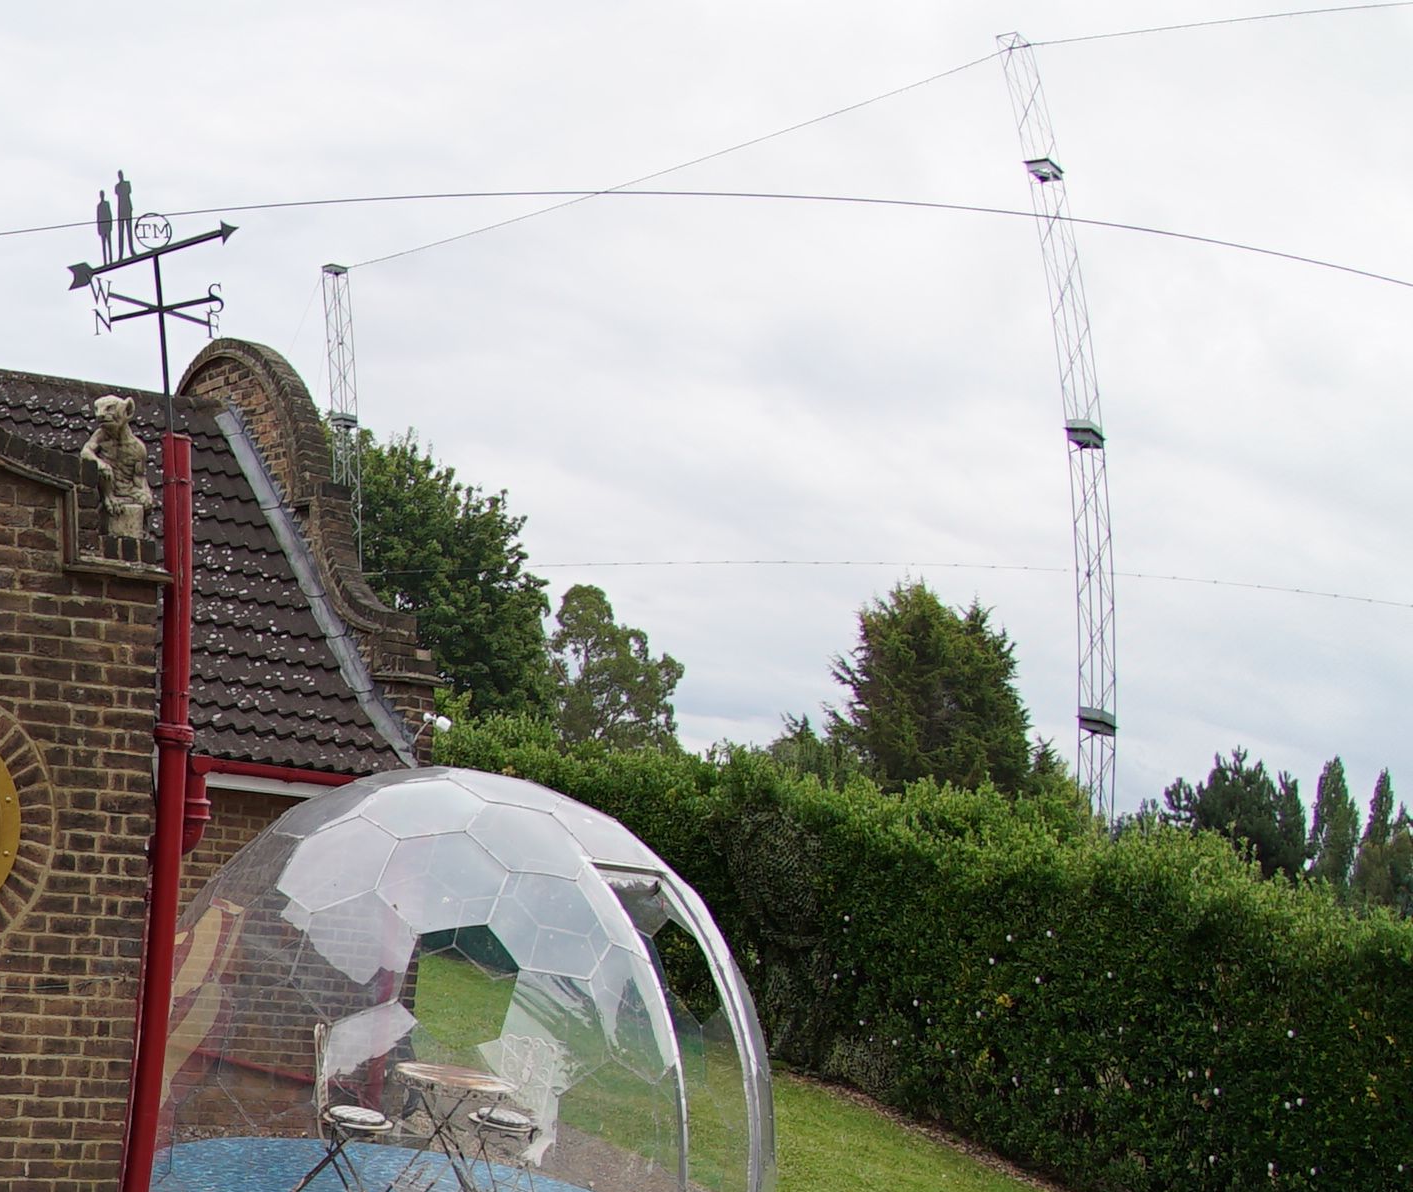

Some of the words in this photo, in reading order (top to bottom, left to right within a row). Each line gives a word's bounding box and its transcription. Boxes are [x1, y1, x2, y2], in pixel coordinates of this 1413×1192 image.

[137, 223, 170, 239] TM
[86, 272, 113, 308] W
[207, 282, 225, 313] S
[92, 306, 112, 336] N
[206, 309, 223, 340] E
